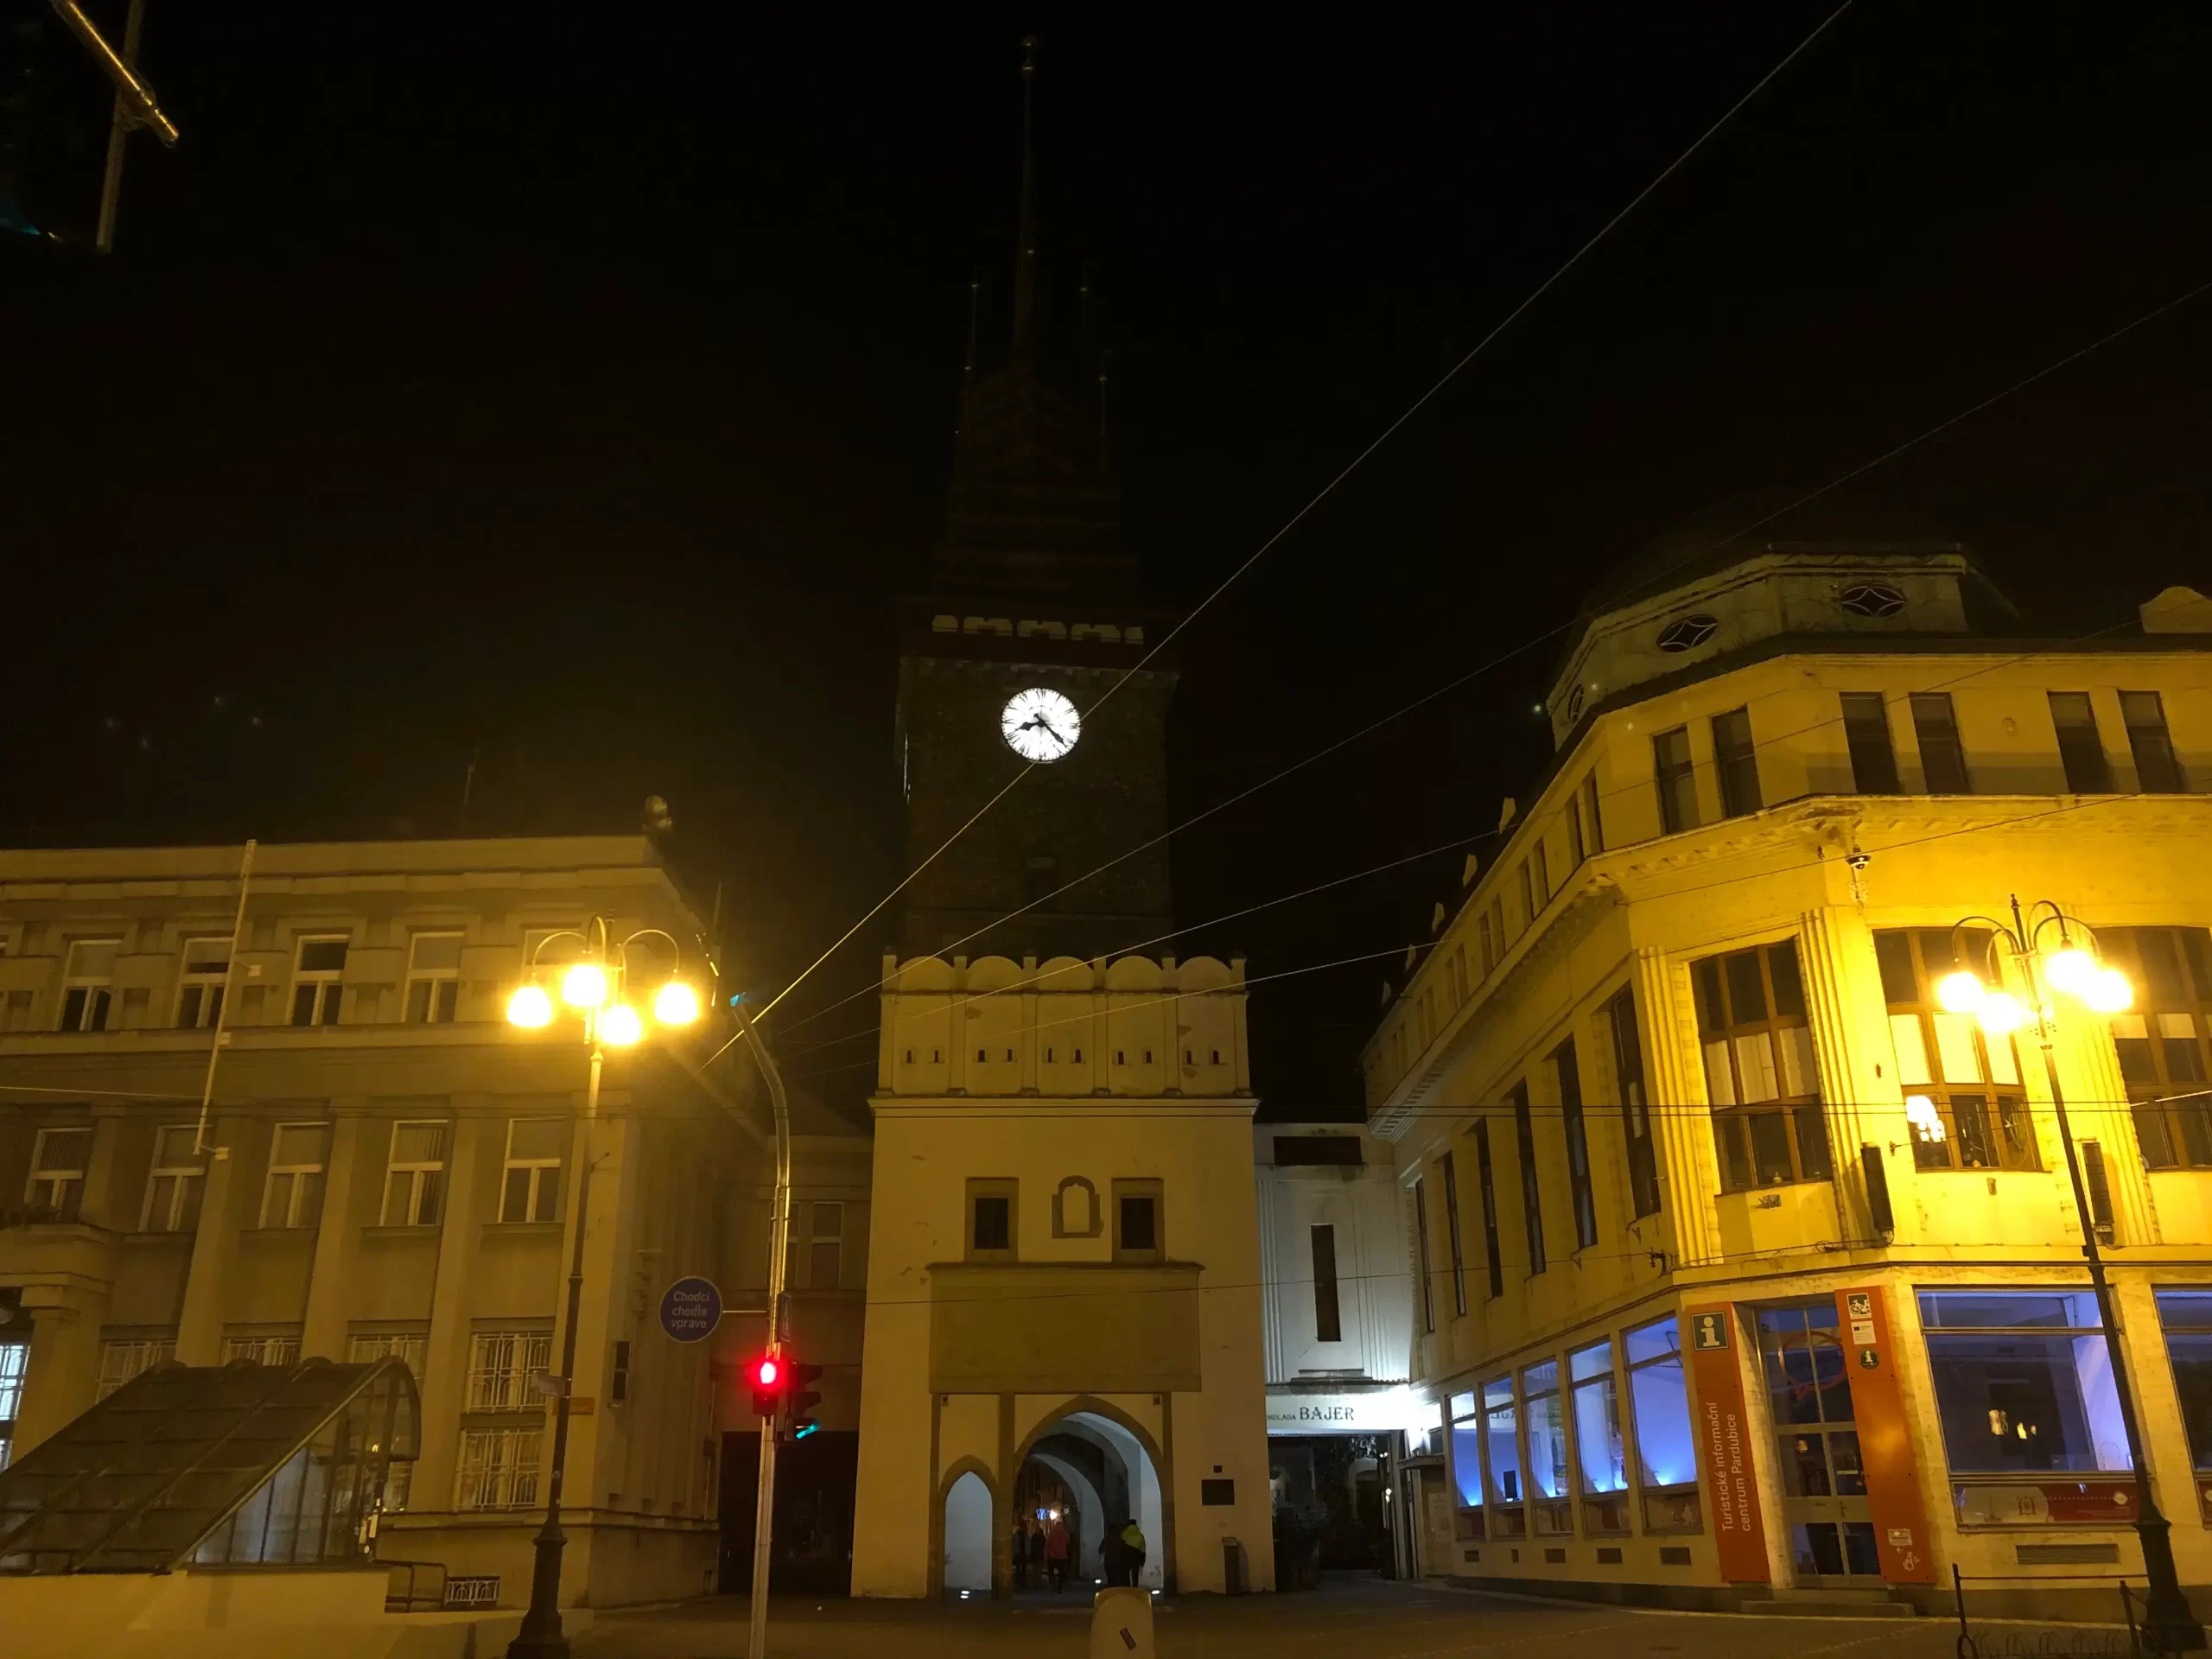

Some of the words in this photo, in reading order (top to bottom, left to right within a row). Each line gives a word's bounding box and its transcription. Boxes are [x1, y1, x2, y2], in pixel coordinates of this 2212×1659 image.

[673, 1290, 709, 1301] Chodci
[671, 1319, 707, 1330] vpravo
[1299, 1406, 1354, 1421] BAJER
[1706, 1402, 1725, 1467] informační
[1726, 1414, 1743, 1474] Pardubice
[1715, 1471, 1733, 1532] Turistické
[1735, 1478, 1751, 1532] centrum
